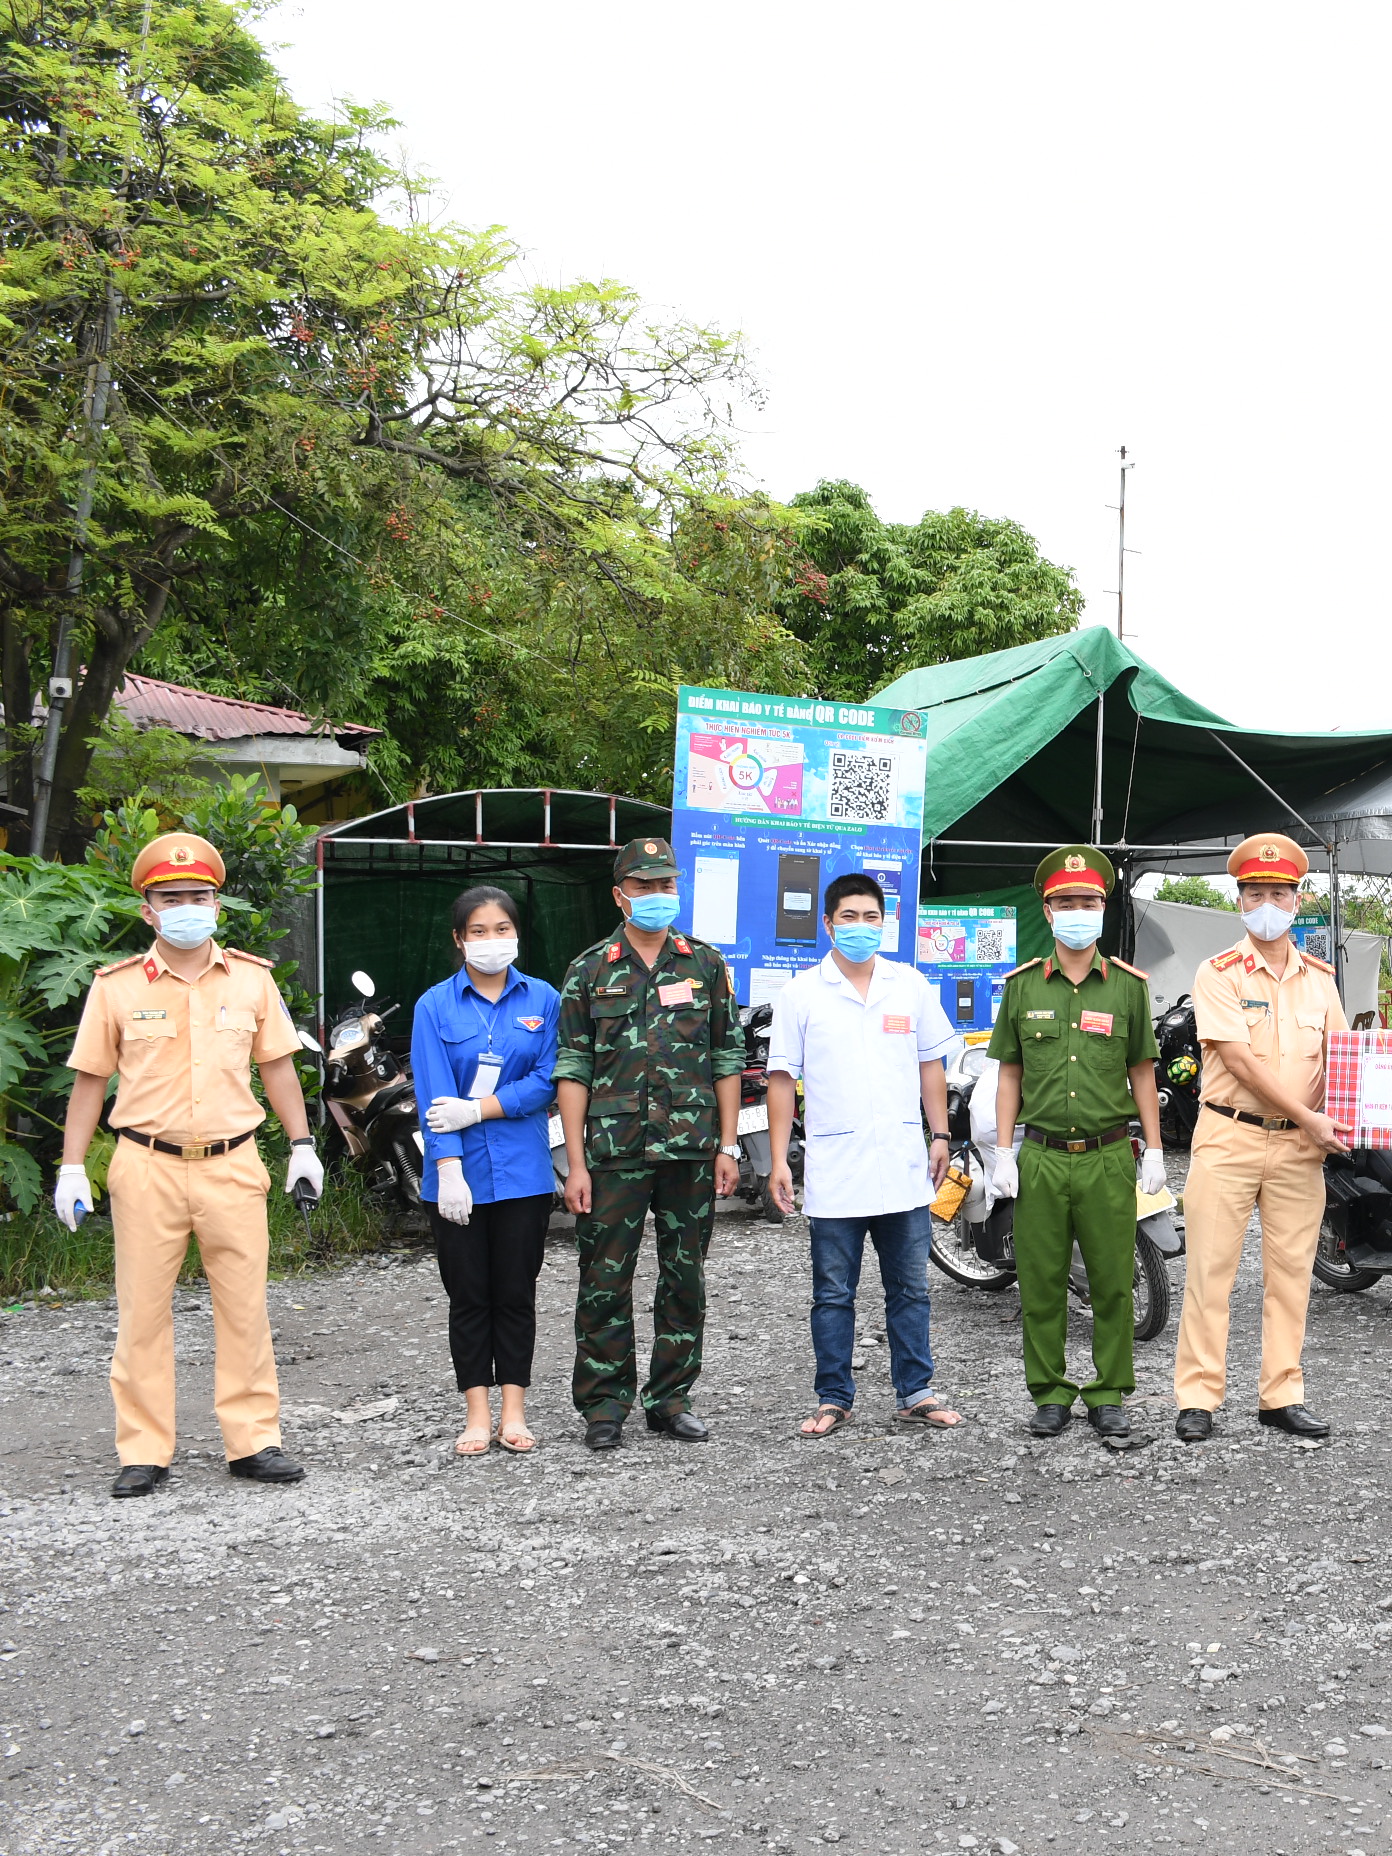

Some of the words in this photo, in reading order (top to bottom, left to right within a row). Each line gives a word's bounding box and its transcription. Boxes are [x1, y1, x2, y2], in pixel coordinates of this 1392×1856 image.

[688, 694, 714, 710] ĐIỂM
[716, 698, 740, 712] KHAI
[742, 701, 762, 715] BÁO
[764, 704, 771, 716] Y
[773, 703, 784, 717] TẾ
[815, 705, 834, 724] QR
[838, 708, 875, 726] CODE
[739, 771, 752, 780] 5K
[969, 908, 978, 917] QR
[979, 908, 994, 916] CODE
